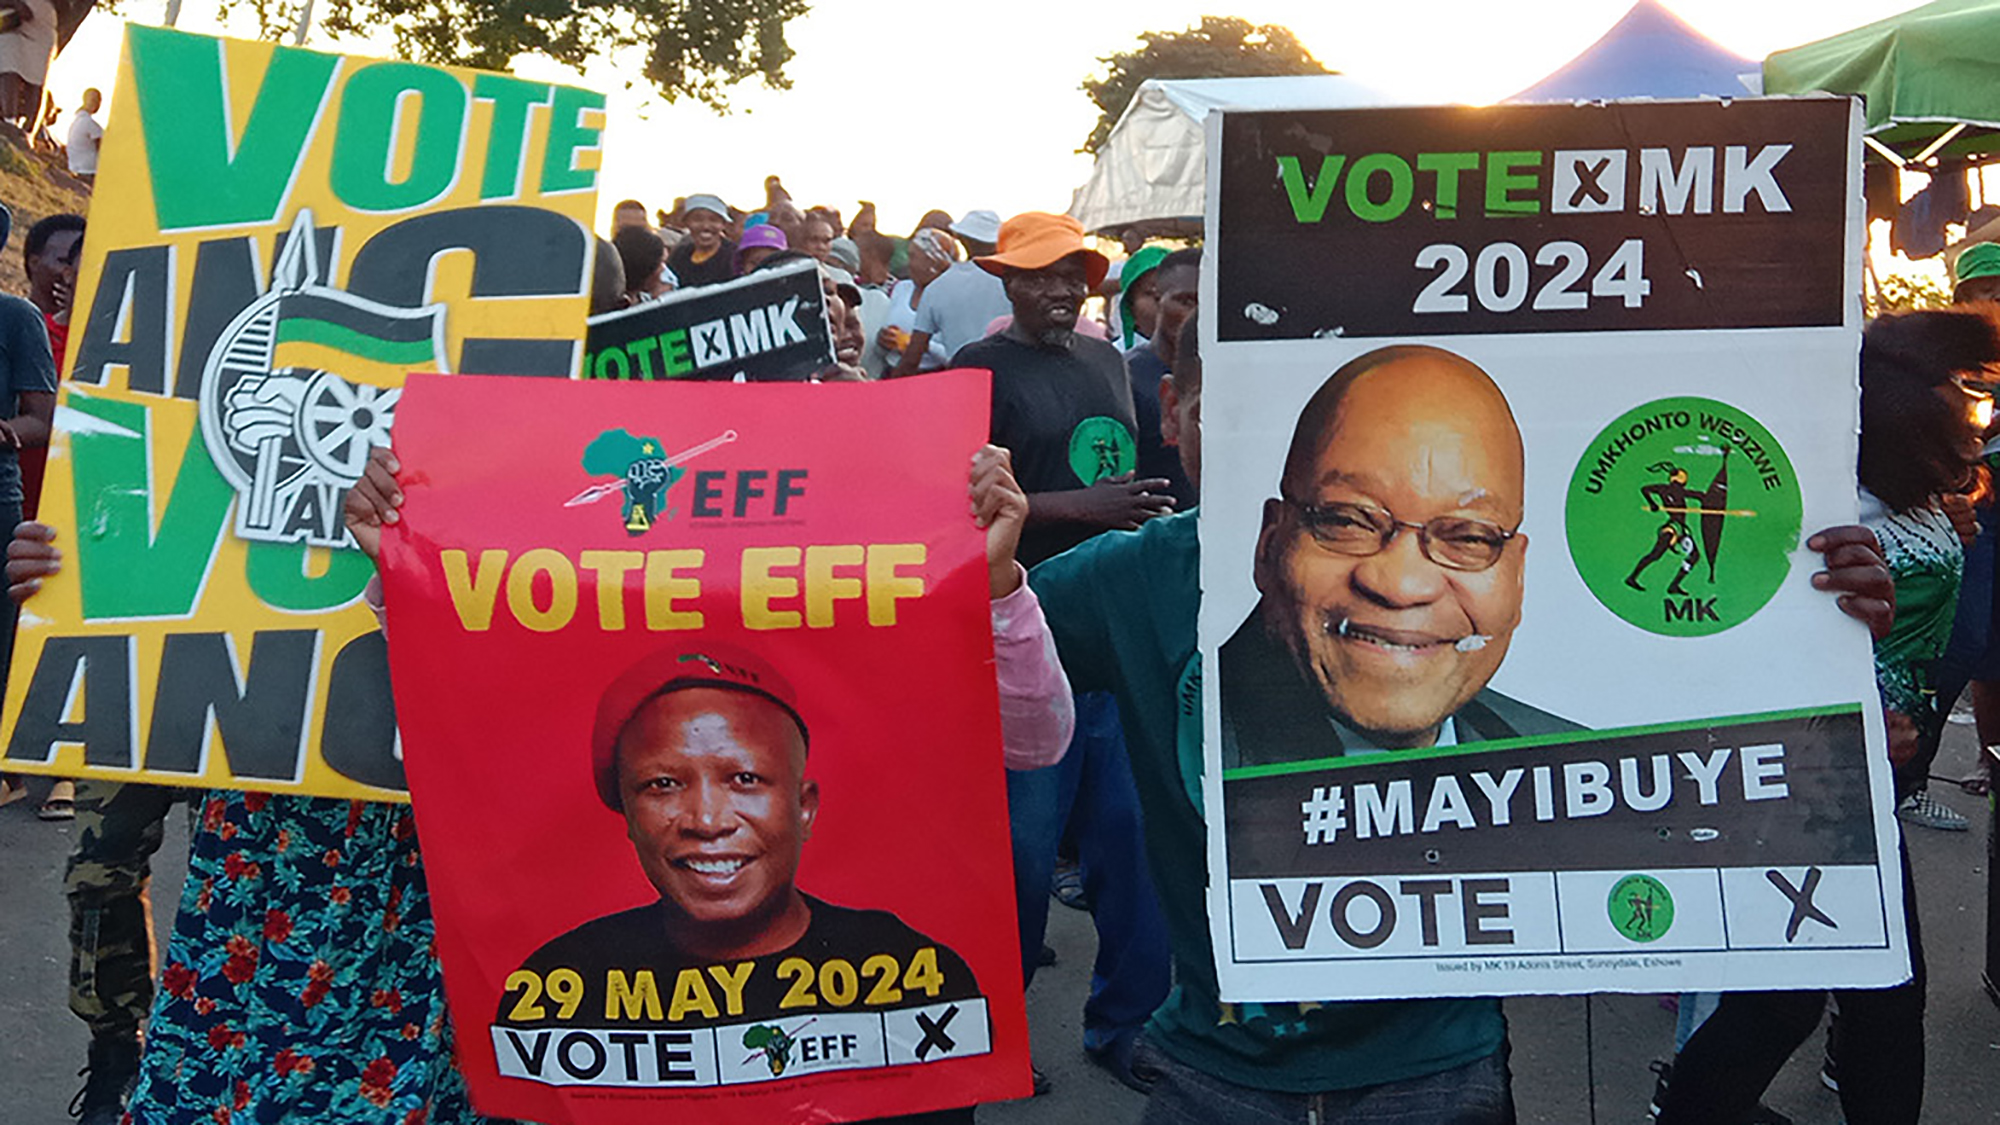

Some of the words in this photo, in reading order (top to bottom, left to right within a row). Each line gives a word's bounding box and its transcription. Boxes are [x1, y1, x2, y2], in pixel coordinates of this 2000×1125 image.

[128, 23, 607, 233] VOTE
[1277, 149, 1543, 222] VOTE
[1638, 143, 1793, 216] MK
[1412, 238, 1652, 314] 2024
[582, 328, 693, 381] OTE
[730, 294, 807, 358] MK
[1585, 411, 1690, 494] UMKHONTO
[1699, 412, 1782, 491] WESIZWE
[691, 469, 809, 518] EFF
[441, 547, 704, 632] VOTE
[740, 543, 927, 630] EFF
[1664, 597, 1720, 622] MK
[1302, 743, 1789, 846] #MAYIBUYE
[1259, 877, 1516, 950] VOTE
[505, 967, 585, 1022] 29
[605, 961, 758, 1022] MAY
[776, 947, 944, 1009] 2024
[1470, 961, 1482, 974] by
[1484, 960, 1501, 971] MK
[506, 1030, 698, 1083] VOTE
[801, 1034, 858, 1062] EFF
